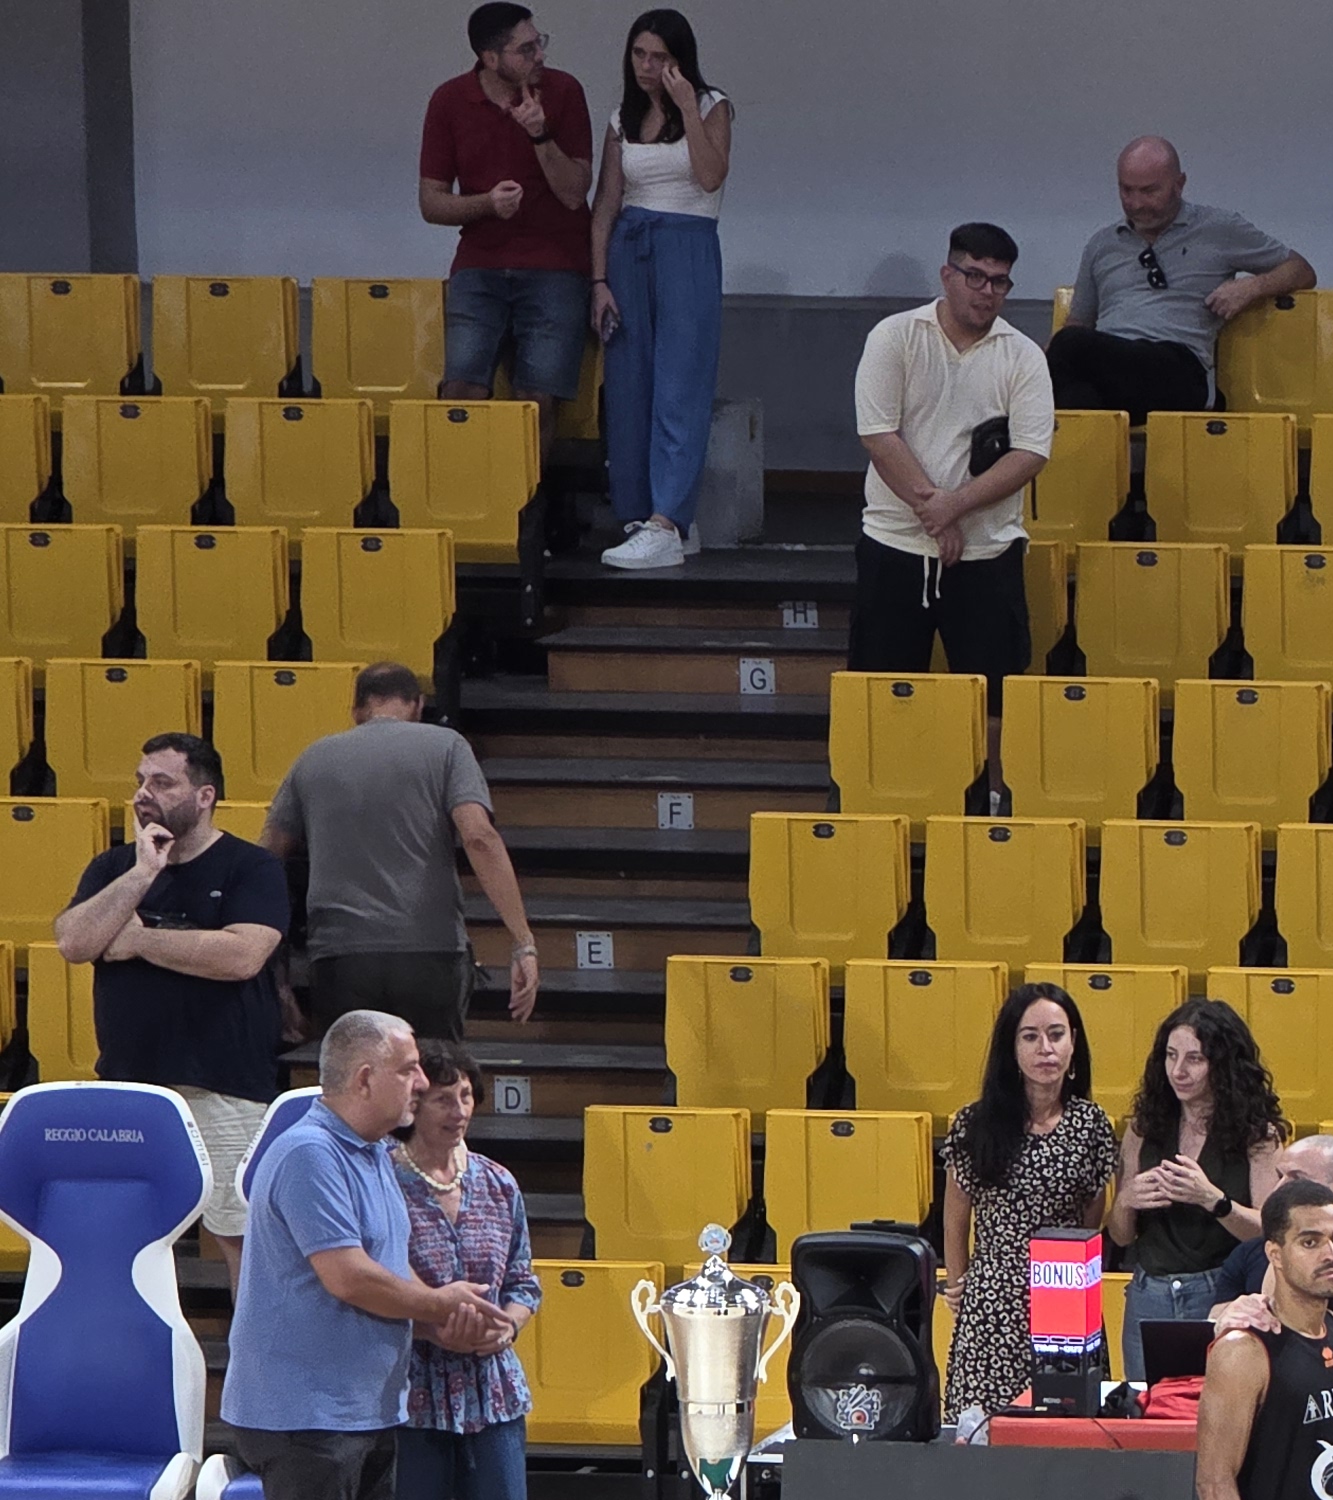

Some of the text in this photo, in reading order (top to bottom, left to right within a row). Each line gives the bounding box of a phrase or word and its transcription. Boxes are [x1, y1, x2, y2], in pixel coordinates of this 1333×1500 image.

[750, 667, 767, 691] G
[669, 803, 682, 824] F
[588, 941, 602, 964] E
[505, 1086, 521, 1110] D
[44, 1128, 145, 1143] REGGIO CALABRIA
[1032, 1263, 1084, 1287] BONUS
